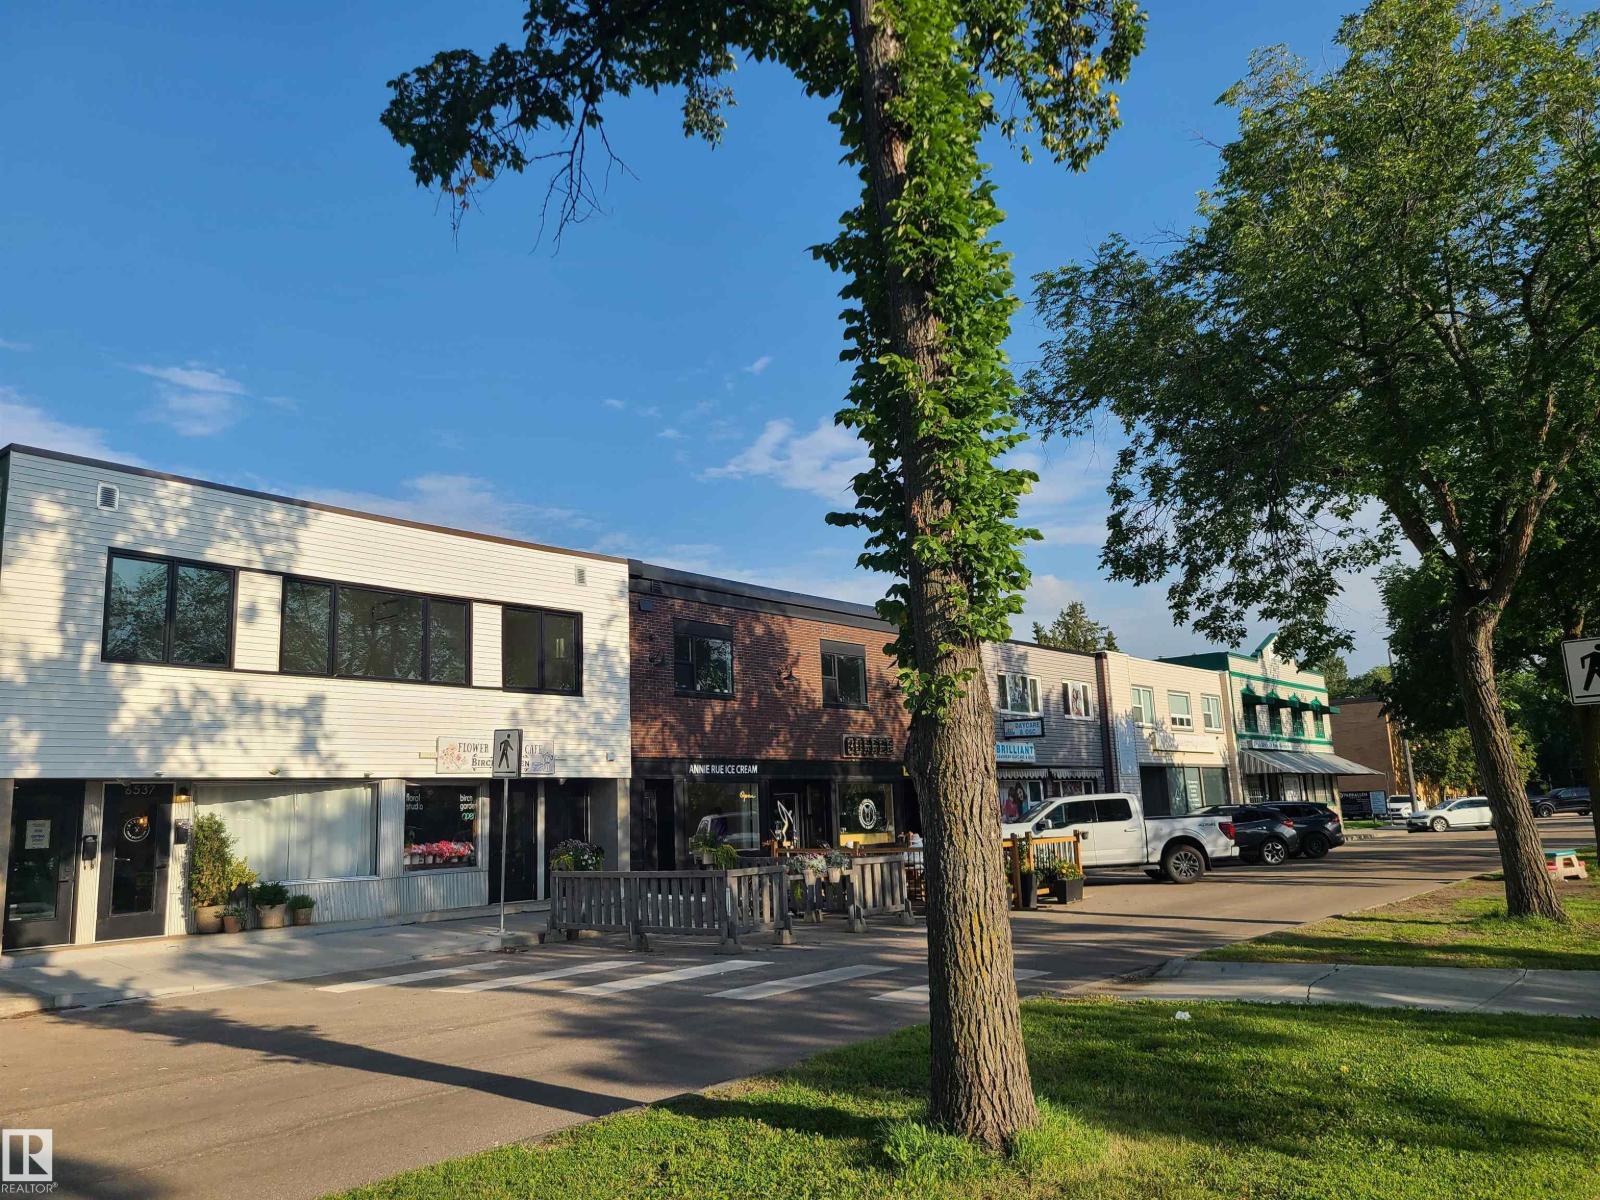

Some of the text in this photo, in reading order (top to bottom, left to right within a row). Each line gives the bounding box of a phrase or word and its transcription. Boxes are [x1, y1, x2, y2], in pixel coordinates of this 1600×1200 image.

[458, 742, 489, 753] FLOWER
[996, 744, 1034, 754] BRILLIANT
[471, 758, 494, 767] BIRC
[689, 764, 758, 774] ANNIE RUE ICE CREAM
